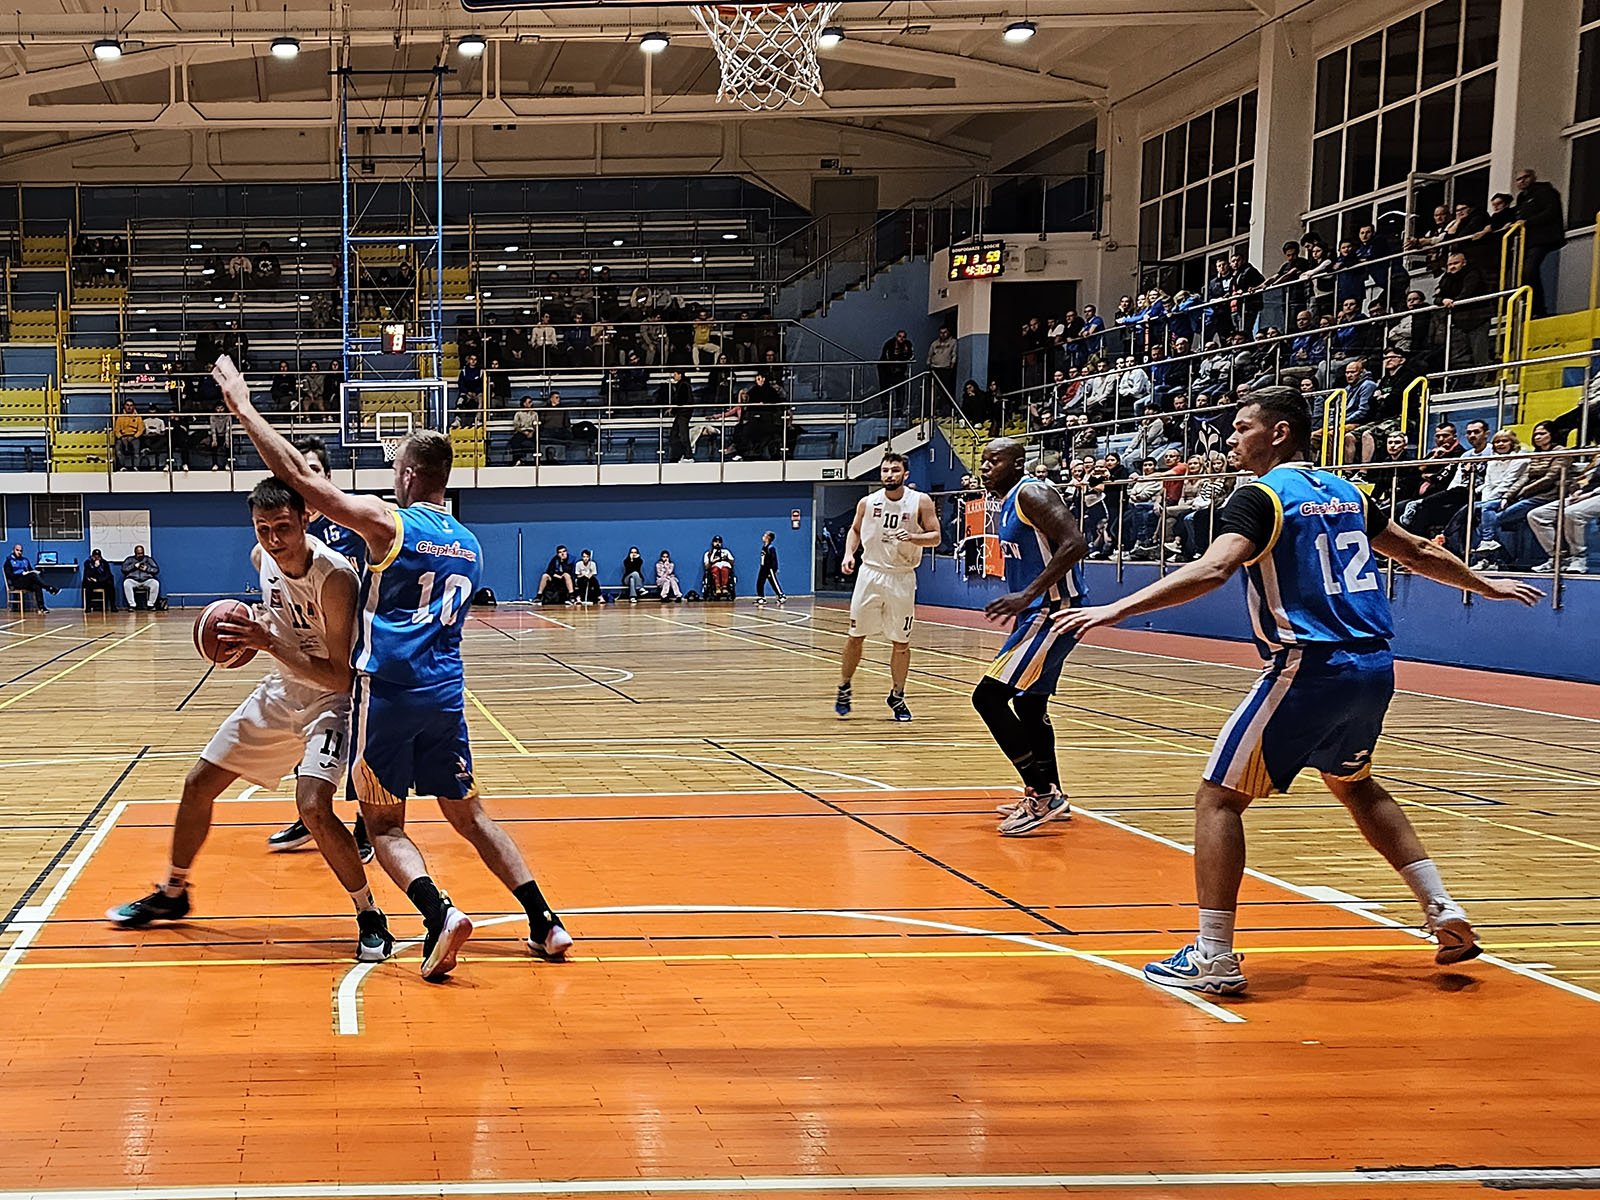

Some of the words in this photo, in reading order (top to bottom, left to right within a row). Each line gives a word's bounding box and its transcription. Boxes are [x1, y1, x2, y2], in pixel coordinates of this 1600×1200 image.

[322, 524, 340, 544] 15
[883, 512, 898, 528] 10
[1314, 530, 1378, 595] 12
[412, 571, 472, 626] 10
[288, 602, 311, 630] 11
[320, 728, 344, 760] 11
